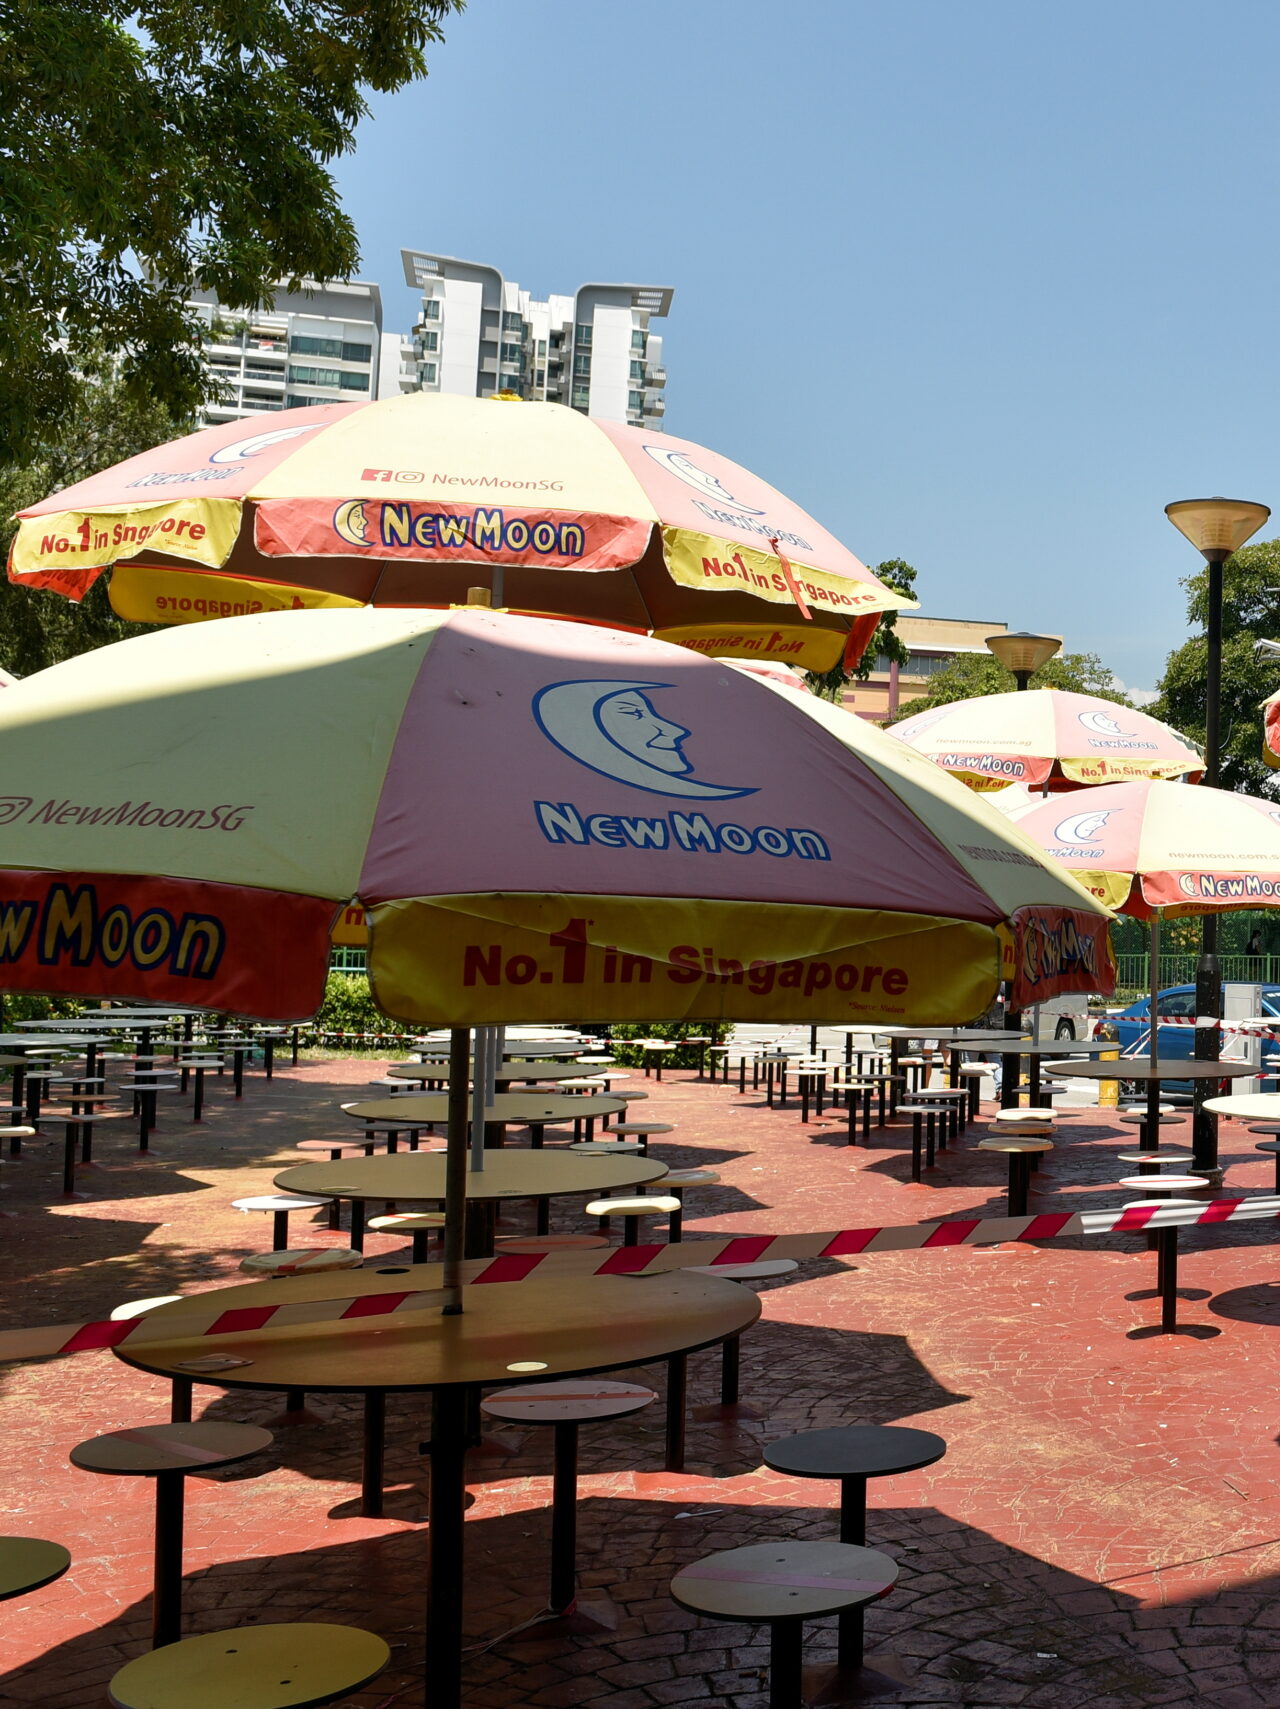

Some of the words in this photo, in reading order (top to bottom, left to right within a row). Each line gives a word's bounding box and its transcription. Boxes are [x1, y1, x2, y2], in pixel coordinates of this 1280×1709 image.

[432, 473, 564, 492] NewMoonSG
[94, 529, 108, 550] in
[749, 569, 769, 589] in
[772, 573, 877, 605] Sngapore
[1110, 766, 1122, 775] in
[27, 799, 255, 831] NewMoonSG
[603, 946, 653, 984] in
[667, 946, 909, 996] Singapore
